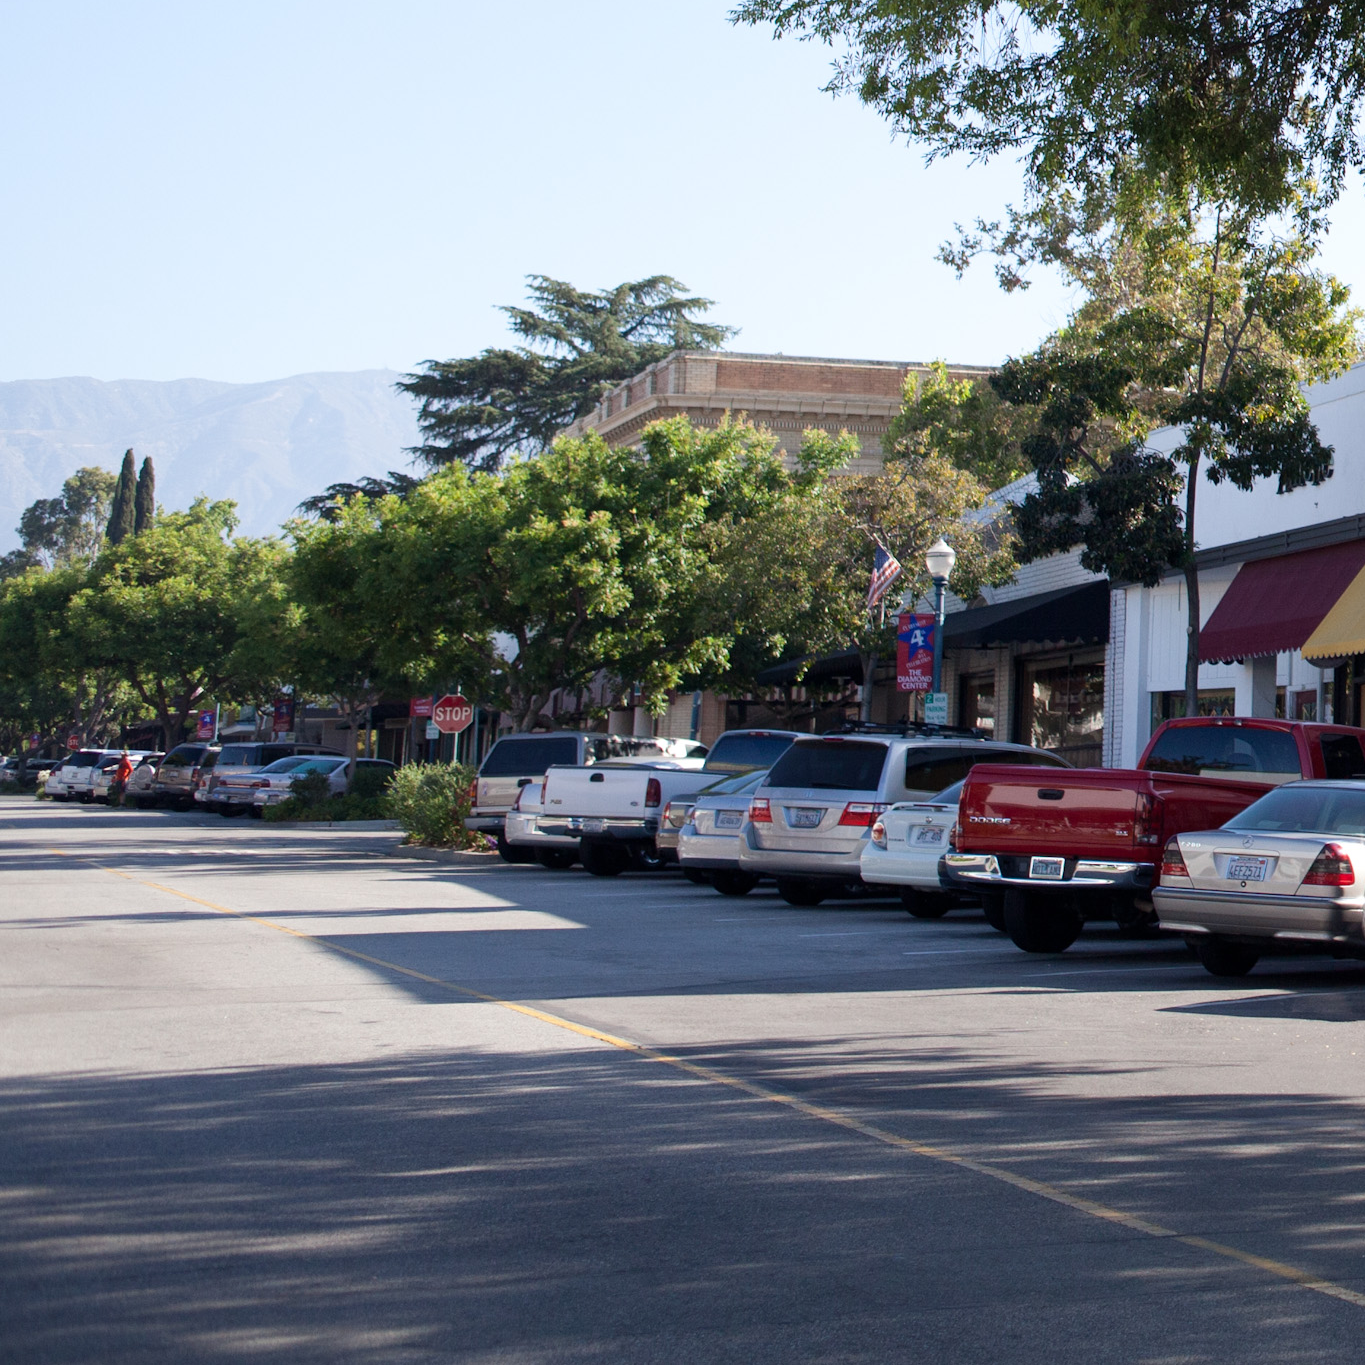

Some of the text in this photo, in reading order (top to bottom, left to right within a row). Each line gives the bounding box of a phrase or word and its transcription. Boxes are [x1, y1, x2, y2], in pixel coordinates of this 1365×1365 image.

[901, 682, 928, 690] CENTER
[435, 707, 471, 721] STOP
[969, 816, 1011, 824] DODGE
